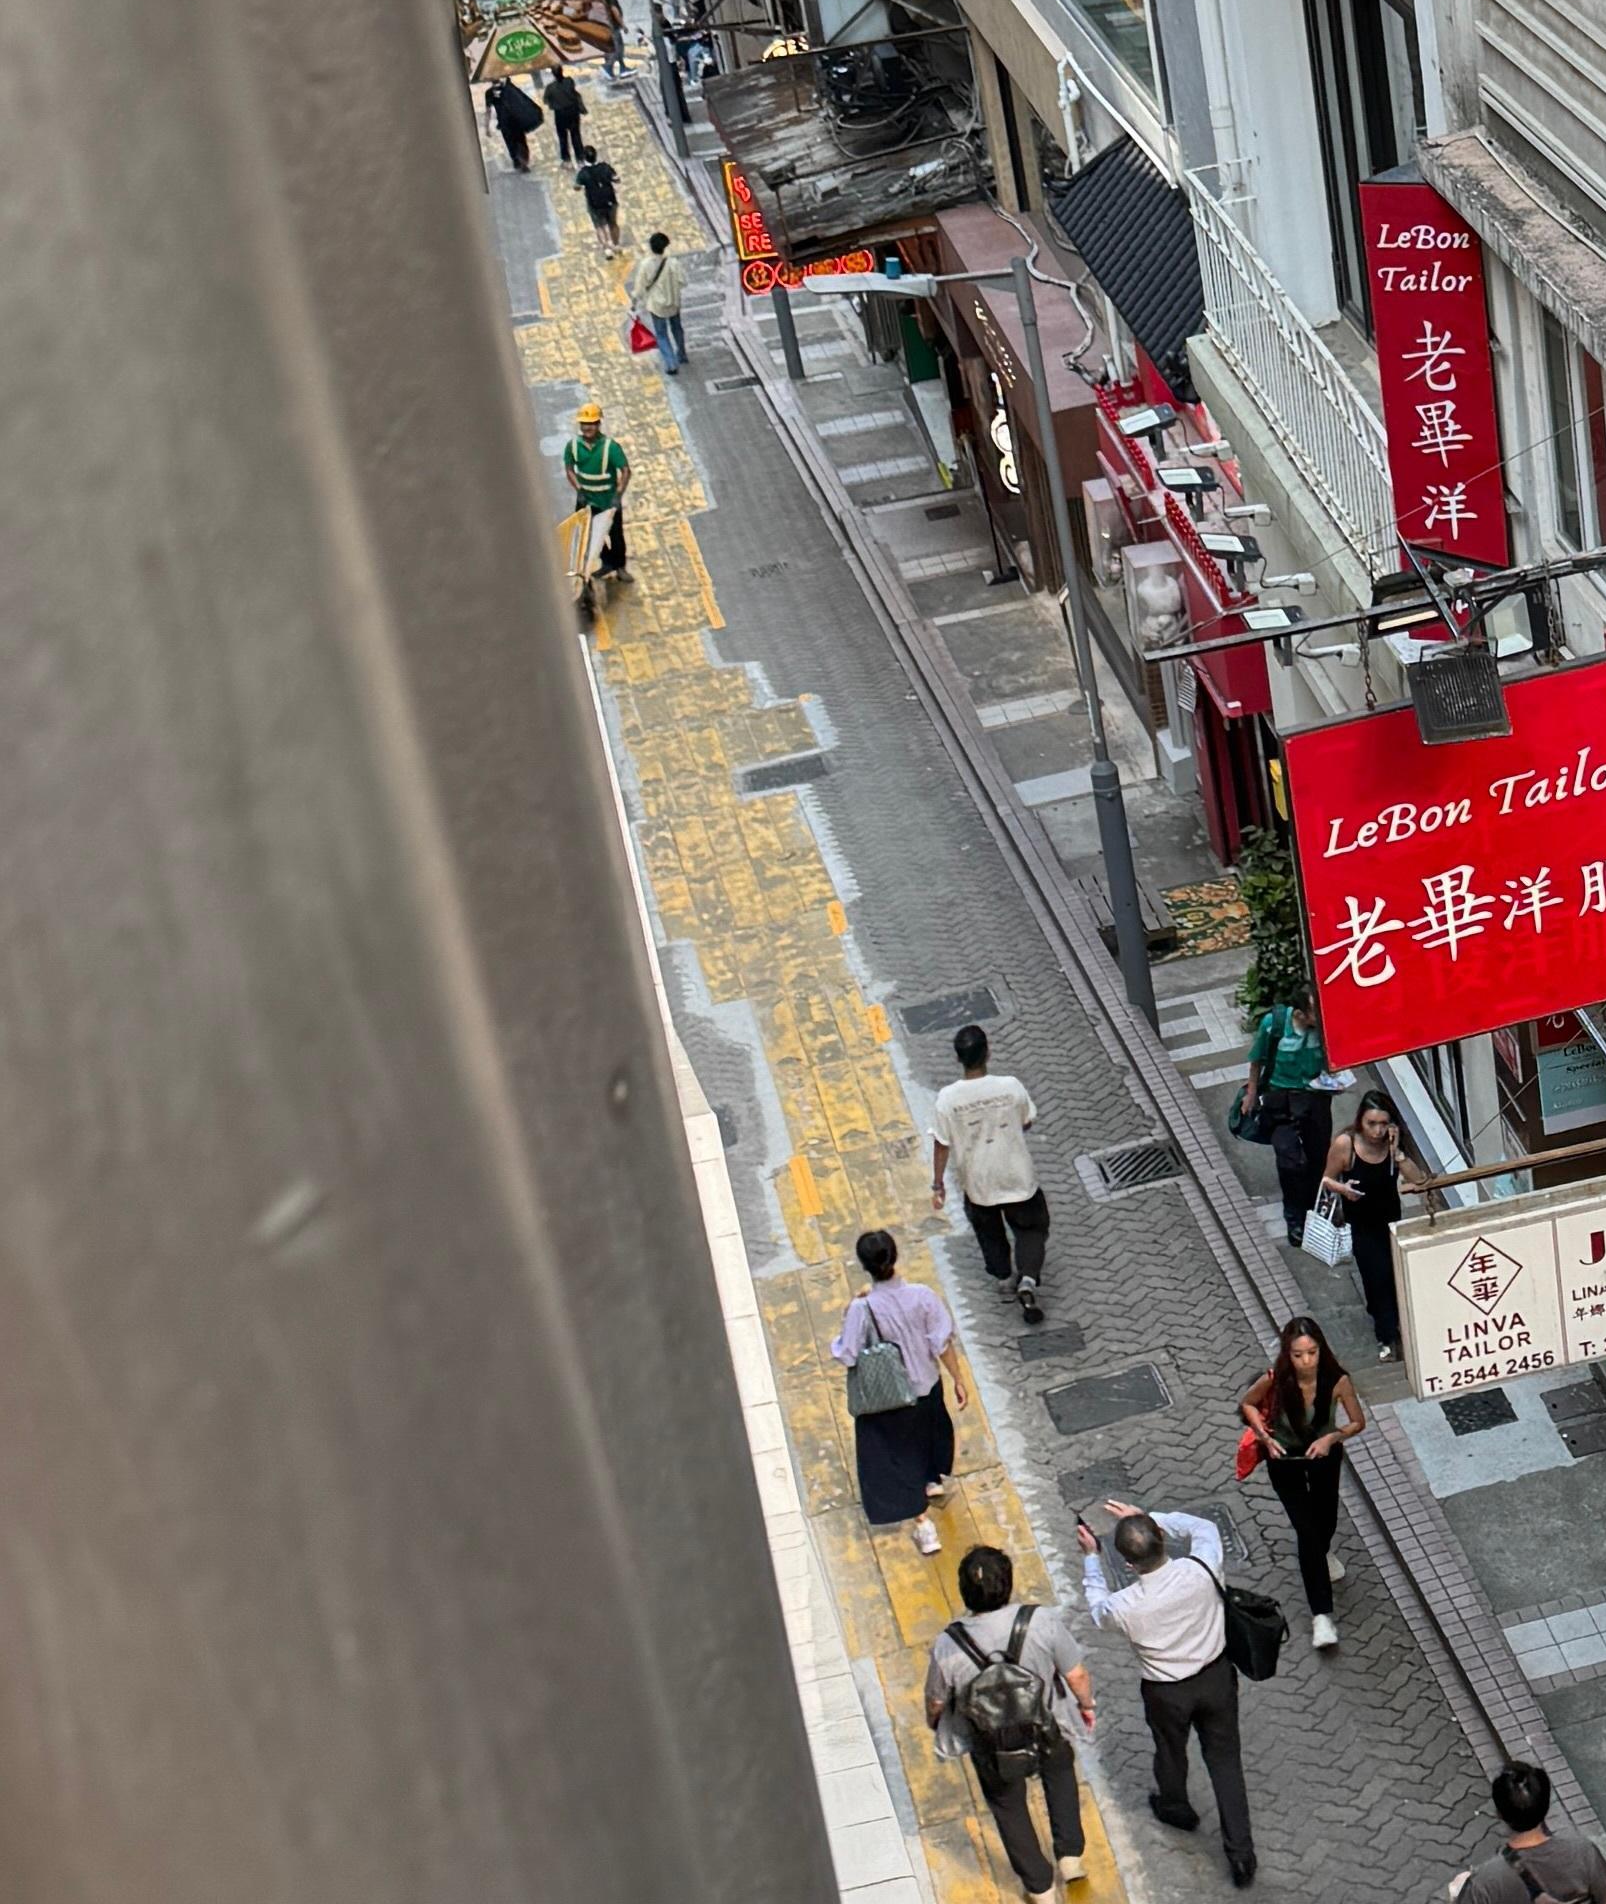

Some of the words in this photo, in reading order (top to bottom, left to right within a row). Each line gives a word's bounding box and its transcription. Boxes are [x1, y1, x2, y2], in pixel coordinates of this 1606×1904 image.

[1377, 223, 1471, 250] LeBon
[1377, 261, 1472, 292] Tailor
[1401, 320, 1478, 614] 老畢洋
[1322, 797, 1472, 859] LeBon
[1447, 1312, 1526, 1345] LINVA
[1442, 1331, 1532, 1364] TAILOR
[1579, 1341, 1598, 1358] T:
[1425, 1376, 1444, 1393] T:
[1450, 1362, 1500, 1388] 2544
[1505, 1349, 1555, 1377] 2456
